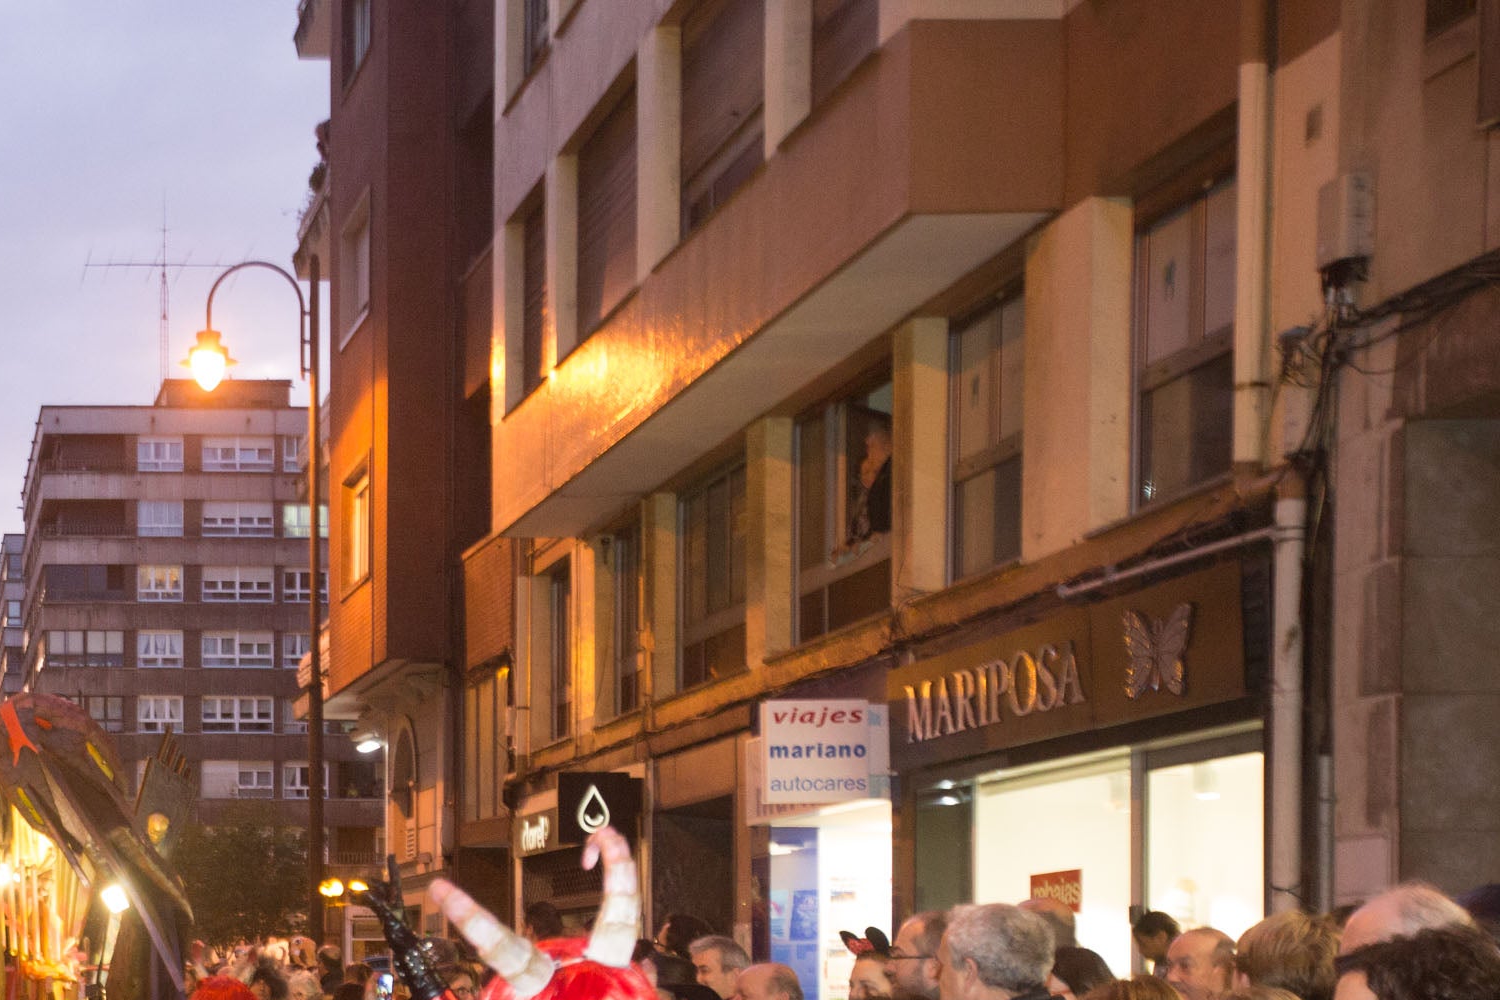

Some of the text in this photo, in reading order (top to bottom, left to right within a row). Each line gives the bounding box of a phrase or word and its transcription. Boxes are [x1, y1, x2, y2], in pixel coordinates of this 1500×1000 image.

[904, 640, 1086, 744] MARIPOSA
[773, 706, 864, 728] viajes
[769, 742, 867, 759] mariano
[770, 775, 867, 792] autocares
